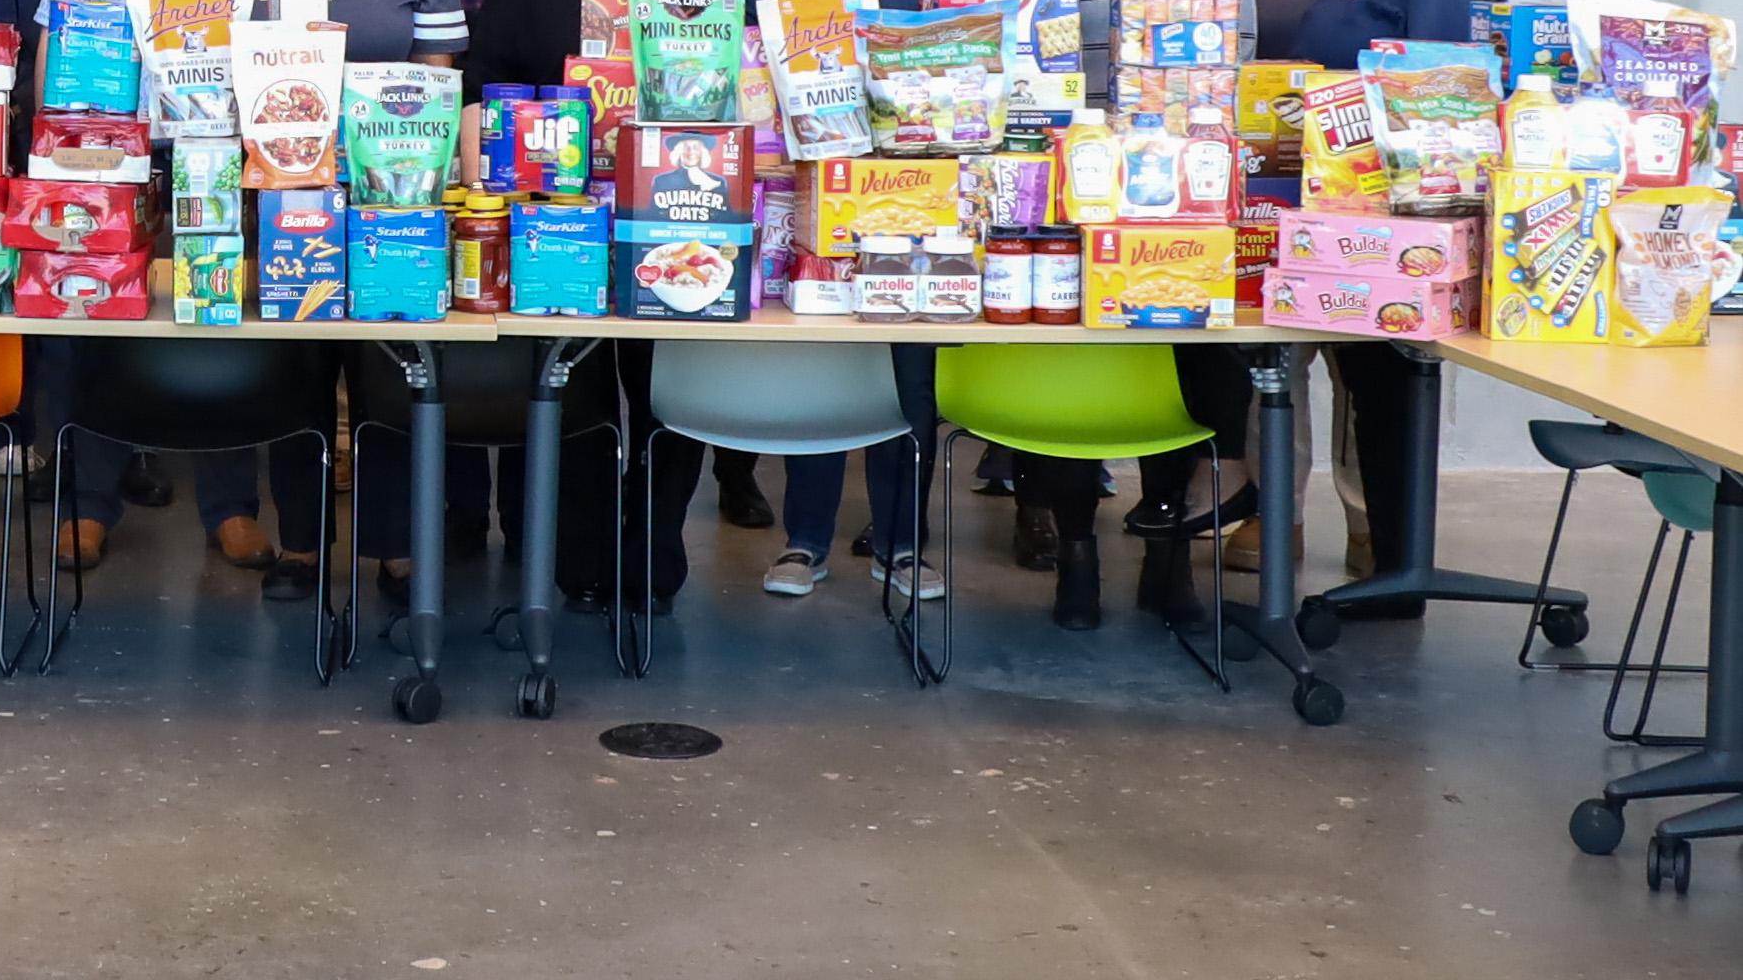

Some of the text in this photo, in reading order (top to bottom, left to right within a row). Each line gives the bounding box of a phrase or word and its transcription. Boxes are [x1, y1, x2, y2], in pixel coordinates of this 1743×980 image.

[65, 18, 113, 29] StarKist
[640, 22, 732, 41] MINI STICKS
[666, 42, 706, 52] TURKEY
[961, 43, 992, 54] Packs
[1615, 60, 1699, 72] SEASONED
[167, 67, 225, 85] MINIS
[1614, 71, 1701, 84] CROUTONS
[1065, 80, 1078, 93] 52
[376, 92, 401, 104] JACK
[806, 85, 857, 107] MINIS
[1308, 89, 1334, 105] 120
[357, 121, 450, 141] MINI STICKS
[523, 116, 580, 151] Jif
[593, 158, 611, 167] KEY
[834, 163, 844, 177] 8
[860, 168, 931, 197] Velveeta
[332, 192, 345, 209] 6
[653, 189, 724, 210] QUAKER
[669, 206, 710, 221] OATS
[280, 214, 329, 228] Barilla
[536, 220, 587, 233] StarKist
[375, 226, 429, 237] StarKist
[1522, 207, 1576, 250] TWIX
[1102, 233, 1114, 247] 8
[1236, 231, 1276, 244] ormel
[1643, 231, 1692, 253] HONEY
[1131, 238, 1206, 267] Velveeta
[1337, 236, 1390, 256] Buldak
[864, 277, 914, 291] nutella
[927, 277, 977, 291] nutella
[1317, 291, 1370, 311] Buldak
